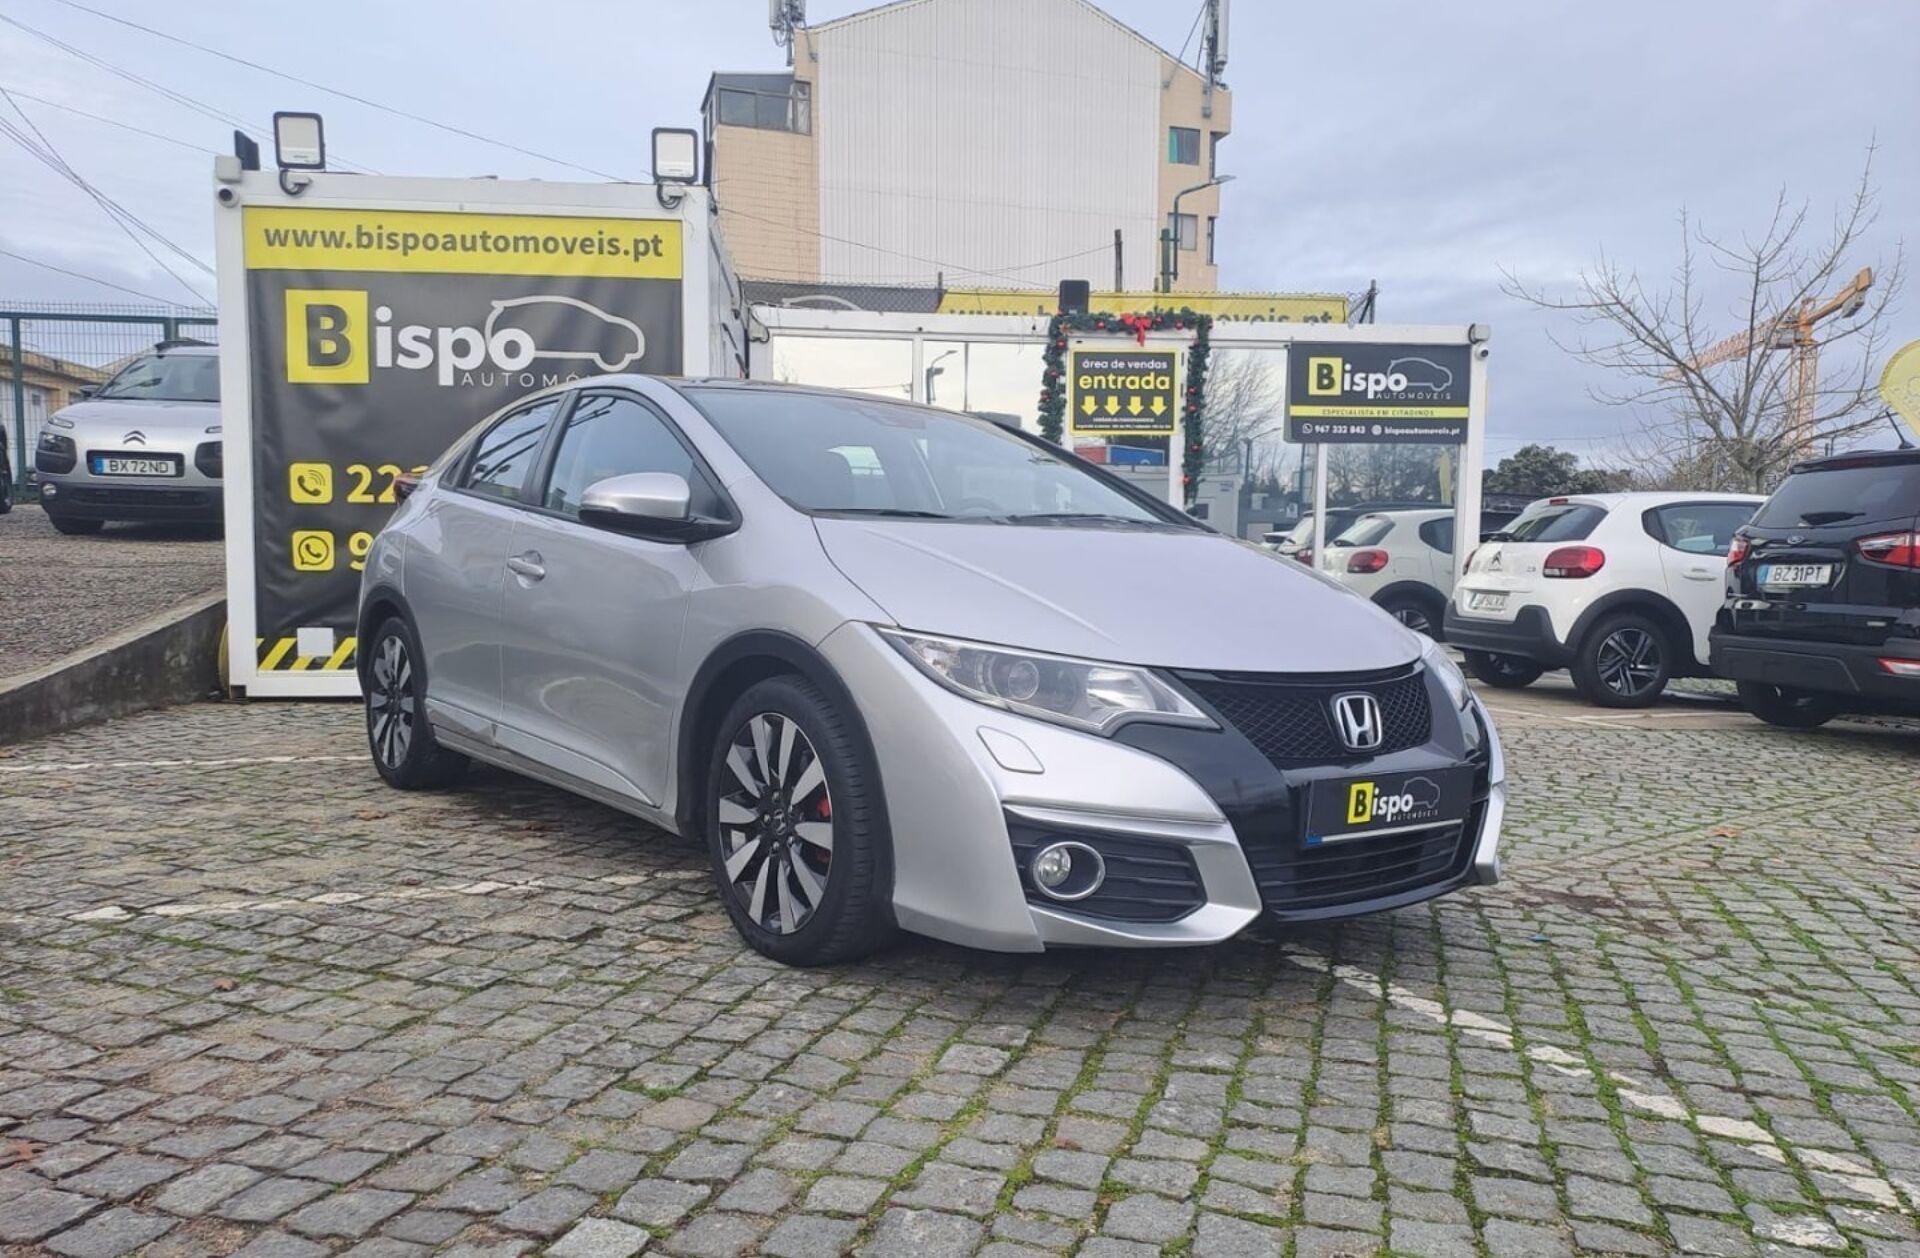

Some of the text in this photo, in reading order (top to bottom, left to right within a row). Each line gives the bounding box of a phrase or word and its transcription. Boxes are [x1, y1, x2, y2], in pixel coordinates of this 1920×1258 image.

[263, 225, 664, 261] www.bispoautomoveis.pt
[304, 304, 536, 387] Bispo
[1079, 371, 1170, 390] entrada
[1082, 359, 1168, 369] área de vendas
[1316, 363, 1408, 400] Bispo
[346, 463, 430, 504] 22
[1353, 787, 1414, 823] Bispo
